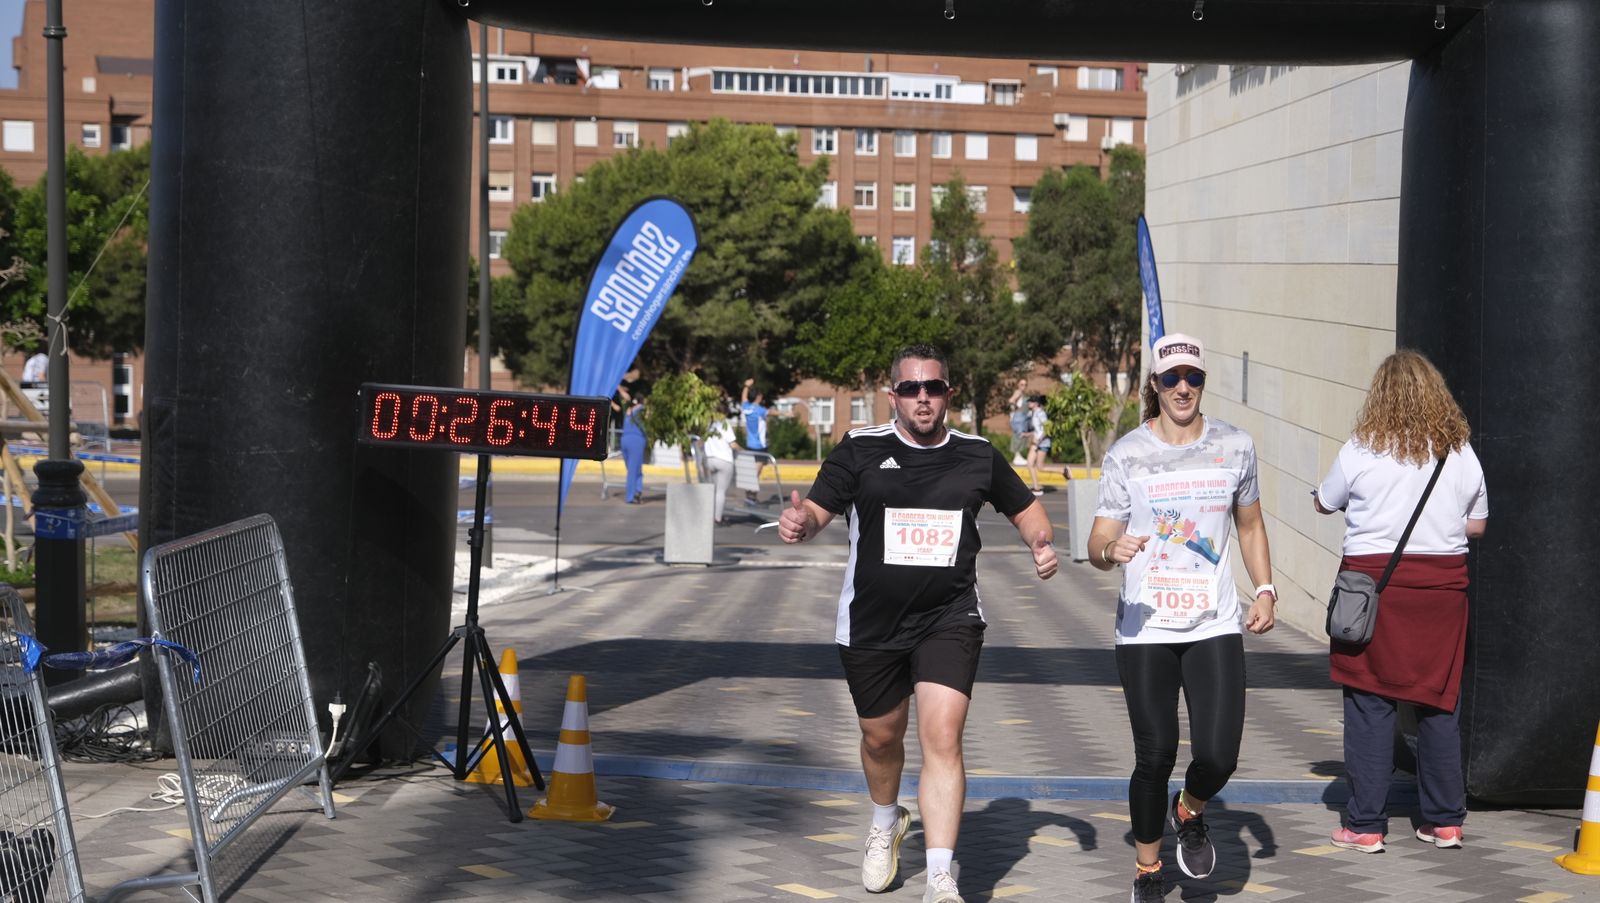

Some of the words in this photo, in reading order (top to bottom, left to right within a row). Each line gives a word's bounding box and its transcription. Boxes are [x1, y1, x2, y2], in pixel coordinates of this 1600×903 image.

[1160, 344, 1200, 358] CrossFit
[372, 392, 596, 448] 00:26:44
[896, 527, 954, 547] 1082
[1152, 591, 1210, 610] 1093
